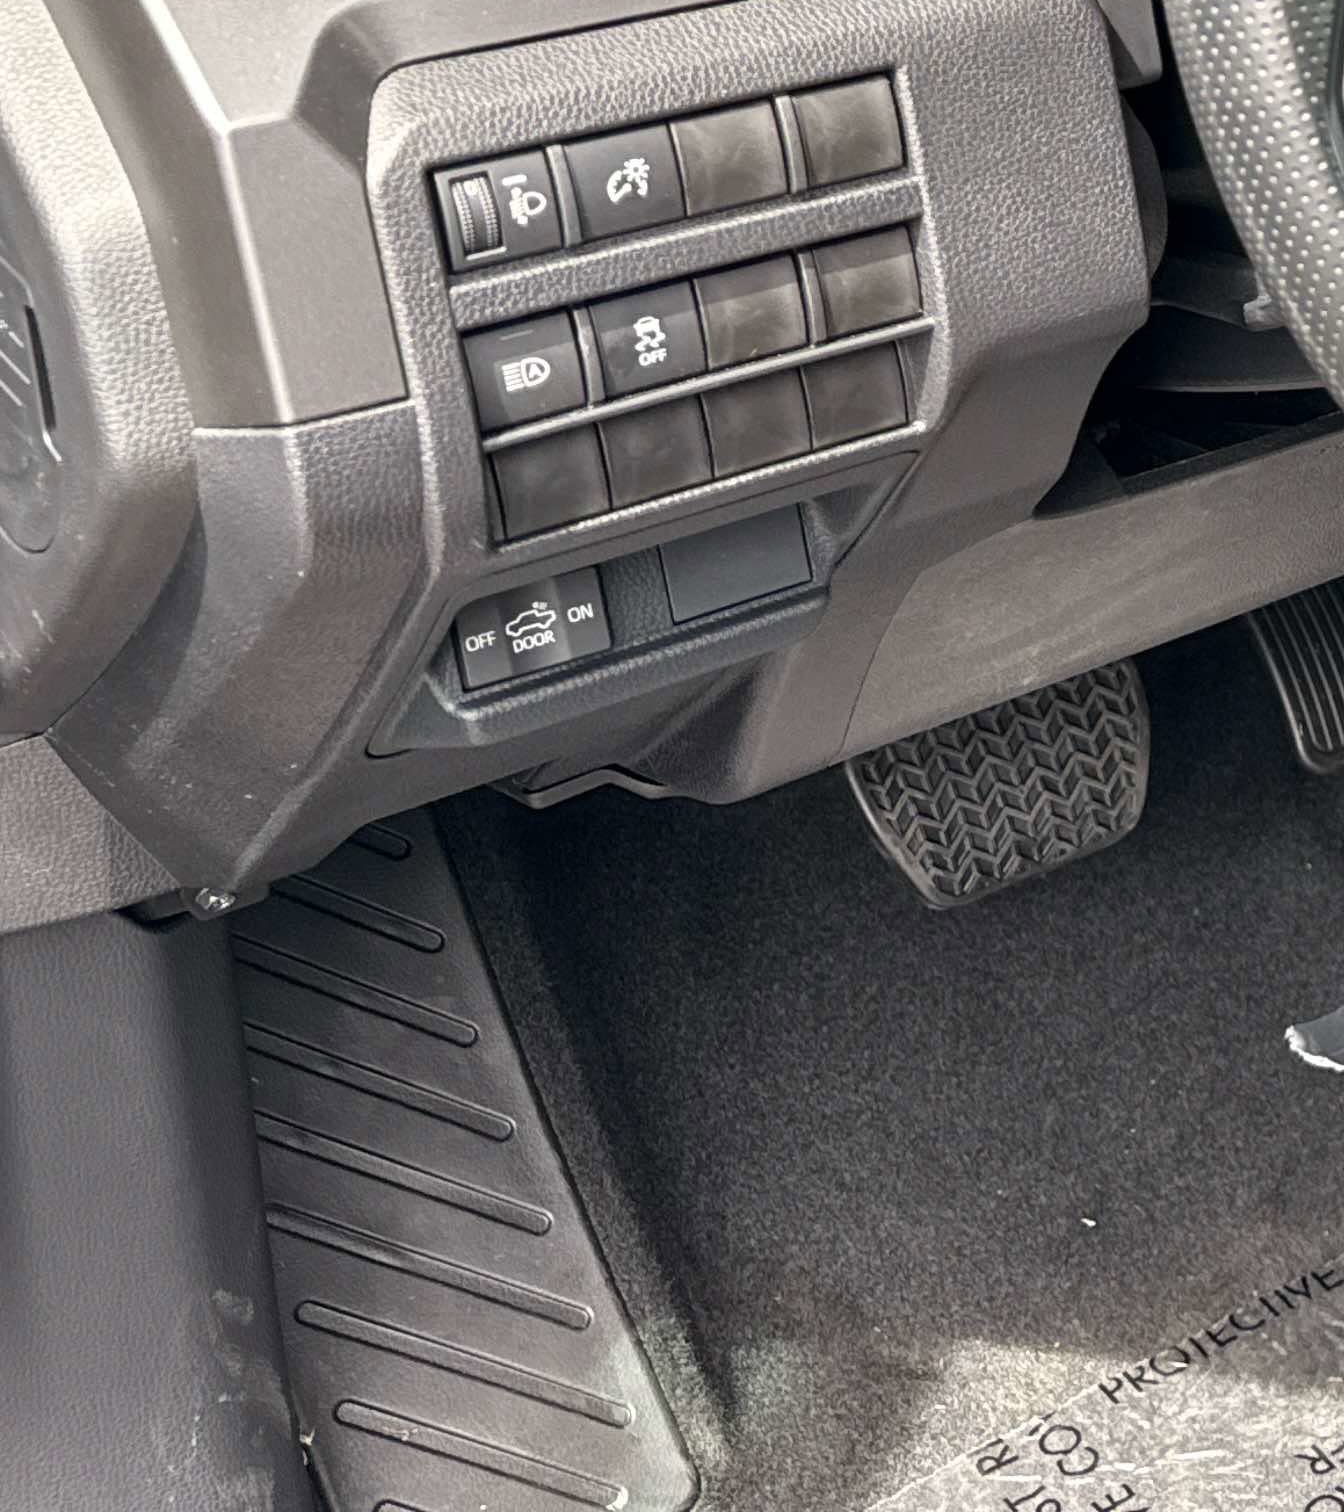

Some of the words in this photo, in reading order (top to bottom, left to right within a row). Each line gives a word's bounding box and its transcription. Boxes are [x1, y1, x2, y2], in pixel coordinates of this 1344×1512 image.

[638, 347, 668, 367] OFF
[567, 602, 594, 623] ON
[465, 630, 497, 652] OFF
[512, 630, 556, 654] DOOR
